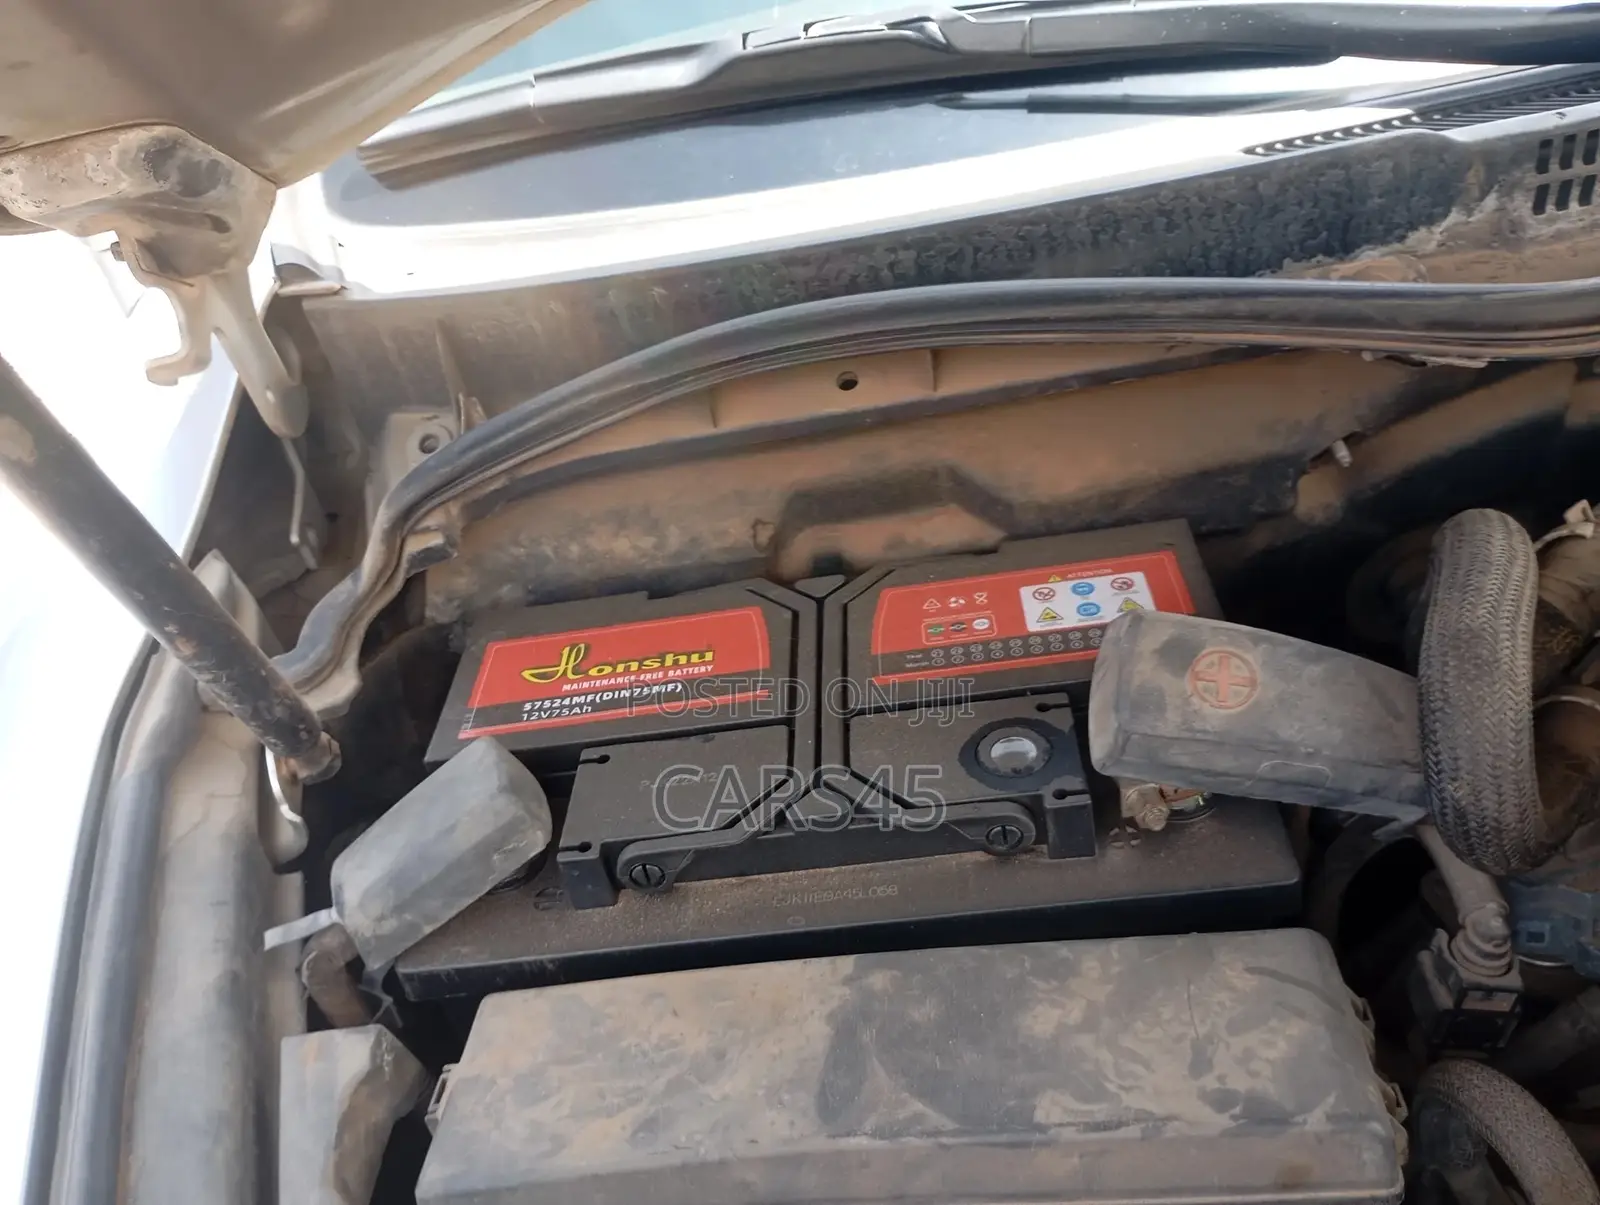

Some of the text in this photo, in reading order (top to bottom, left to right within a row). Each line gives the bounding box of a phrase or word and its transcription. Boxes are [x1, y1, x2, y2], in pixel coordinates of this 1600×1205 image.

[520, 643, 715, 684] Honshu
[667, 664, 714, 678] BATTERY
[522, 705, 593, 722] 12V75Ah
